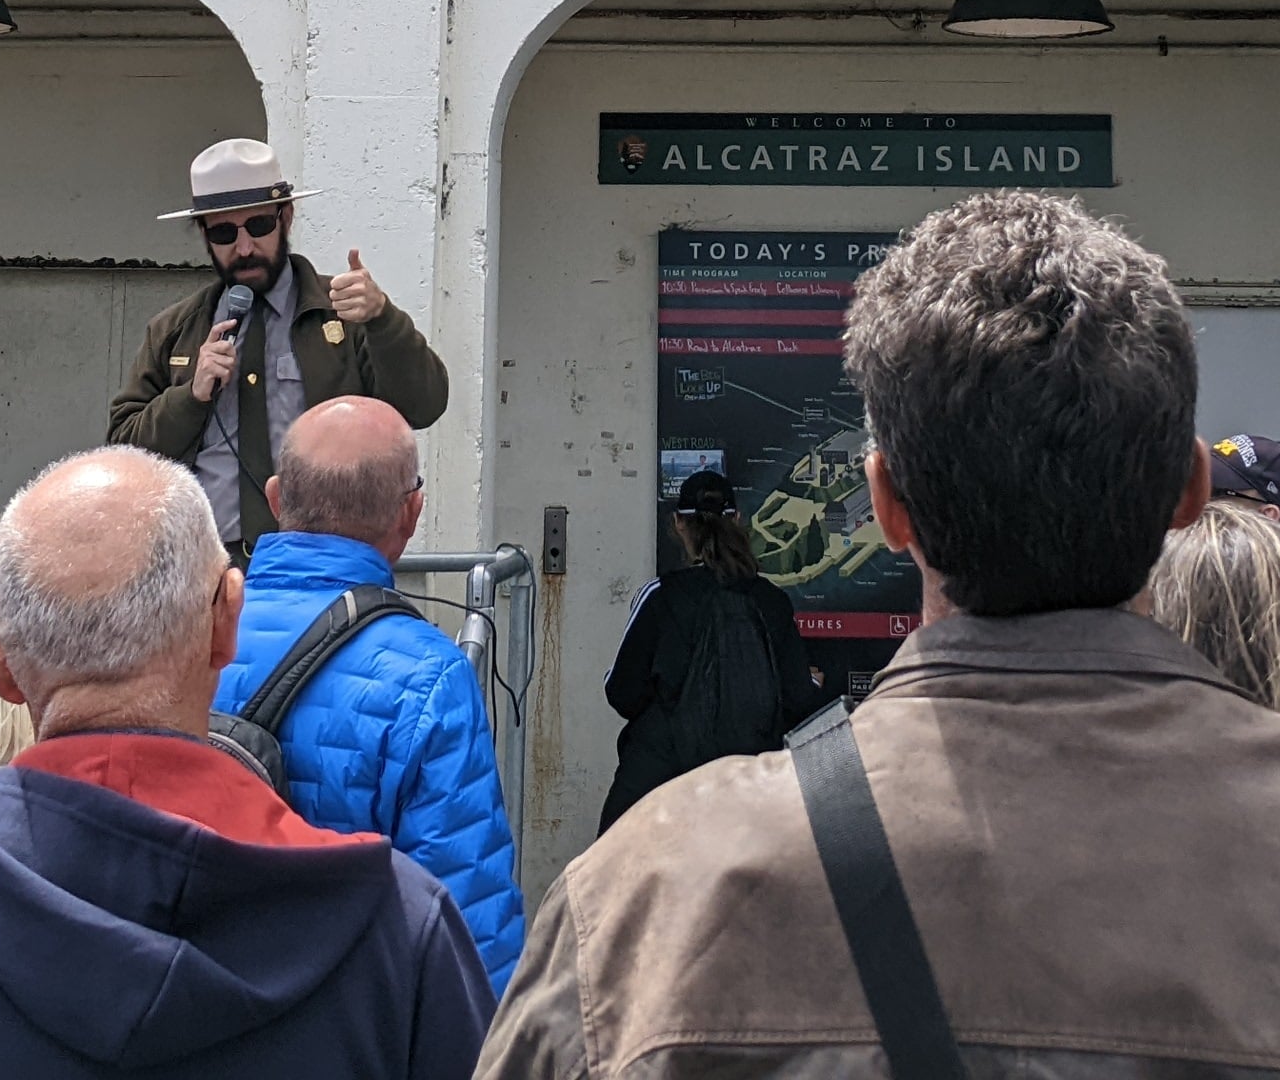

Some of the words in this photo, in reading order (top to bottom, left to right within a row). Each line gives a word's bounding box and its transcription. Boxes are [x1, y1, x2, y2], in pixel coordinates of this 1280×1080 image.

[744, 117, 895, 128] WELCOME
[923, 117, 958, 128] TO
[661, 144, 890, 173] ALCATRAZ
[917, 145, 1082, 173] ISLAND
[688, 242, 826, 261] TODAY'S
[847, 244, 880, 262] PR
[663, 269, 686, 277] TIME
[692, 269, 739, 278] PROGRAM
[779, 270, 827, 278] LOCATION
[710, 340, 720, 352] to
[722, 339, 762, 353] Alcatraz
[798, 619, 842, 630] TURES
